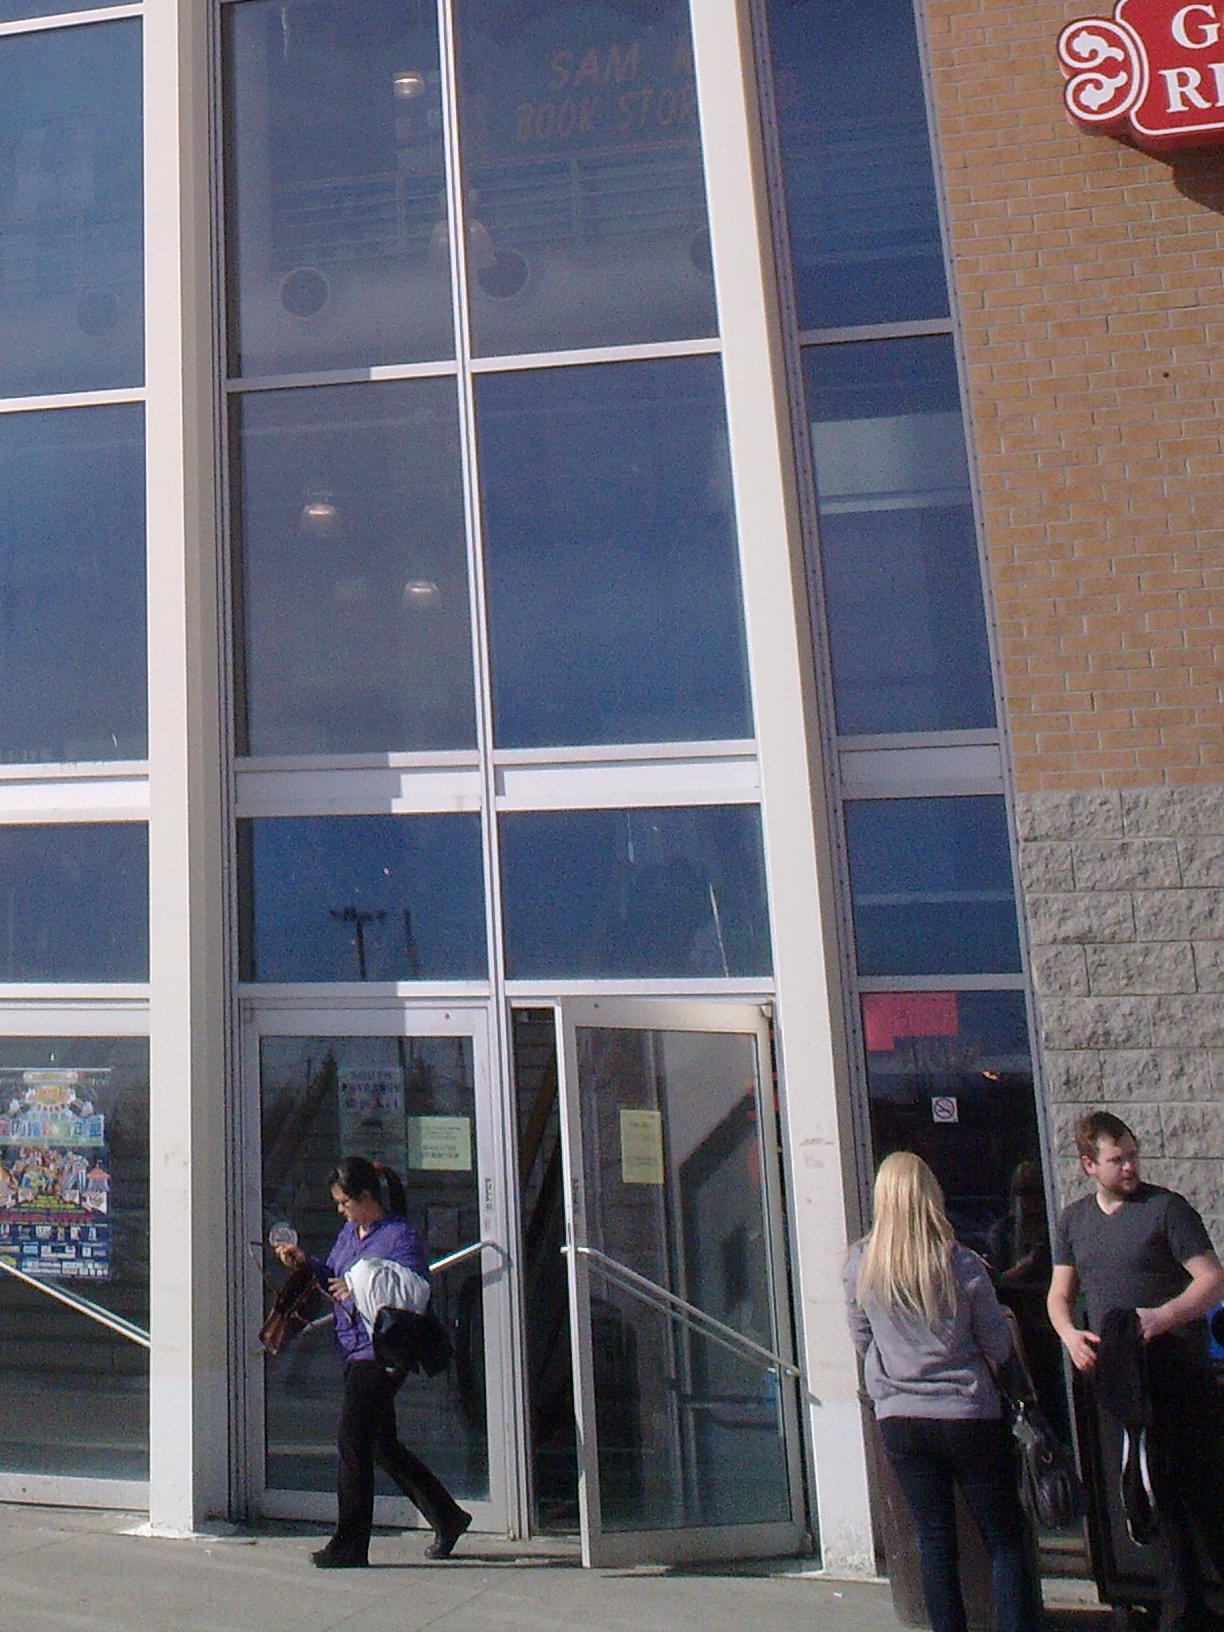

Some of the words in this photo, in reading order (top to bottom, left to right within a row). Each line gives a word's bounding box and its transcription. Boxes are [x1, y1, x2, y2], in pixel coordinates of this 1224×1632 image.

[547, 40, 643, 91] SAM
[514, 98, 600, 143] BOOK
[617, 83, 698, 134] STOR
